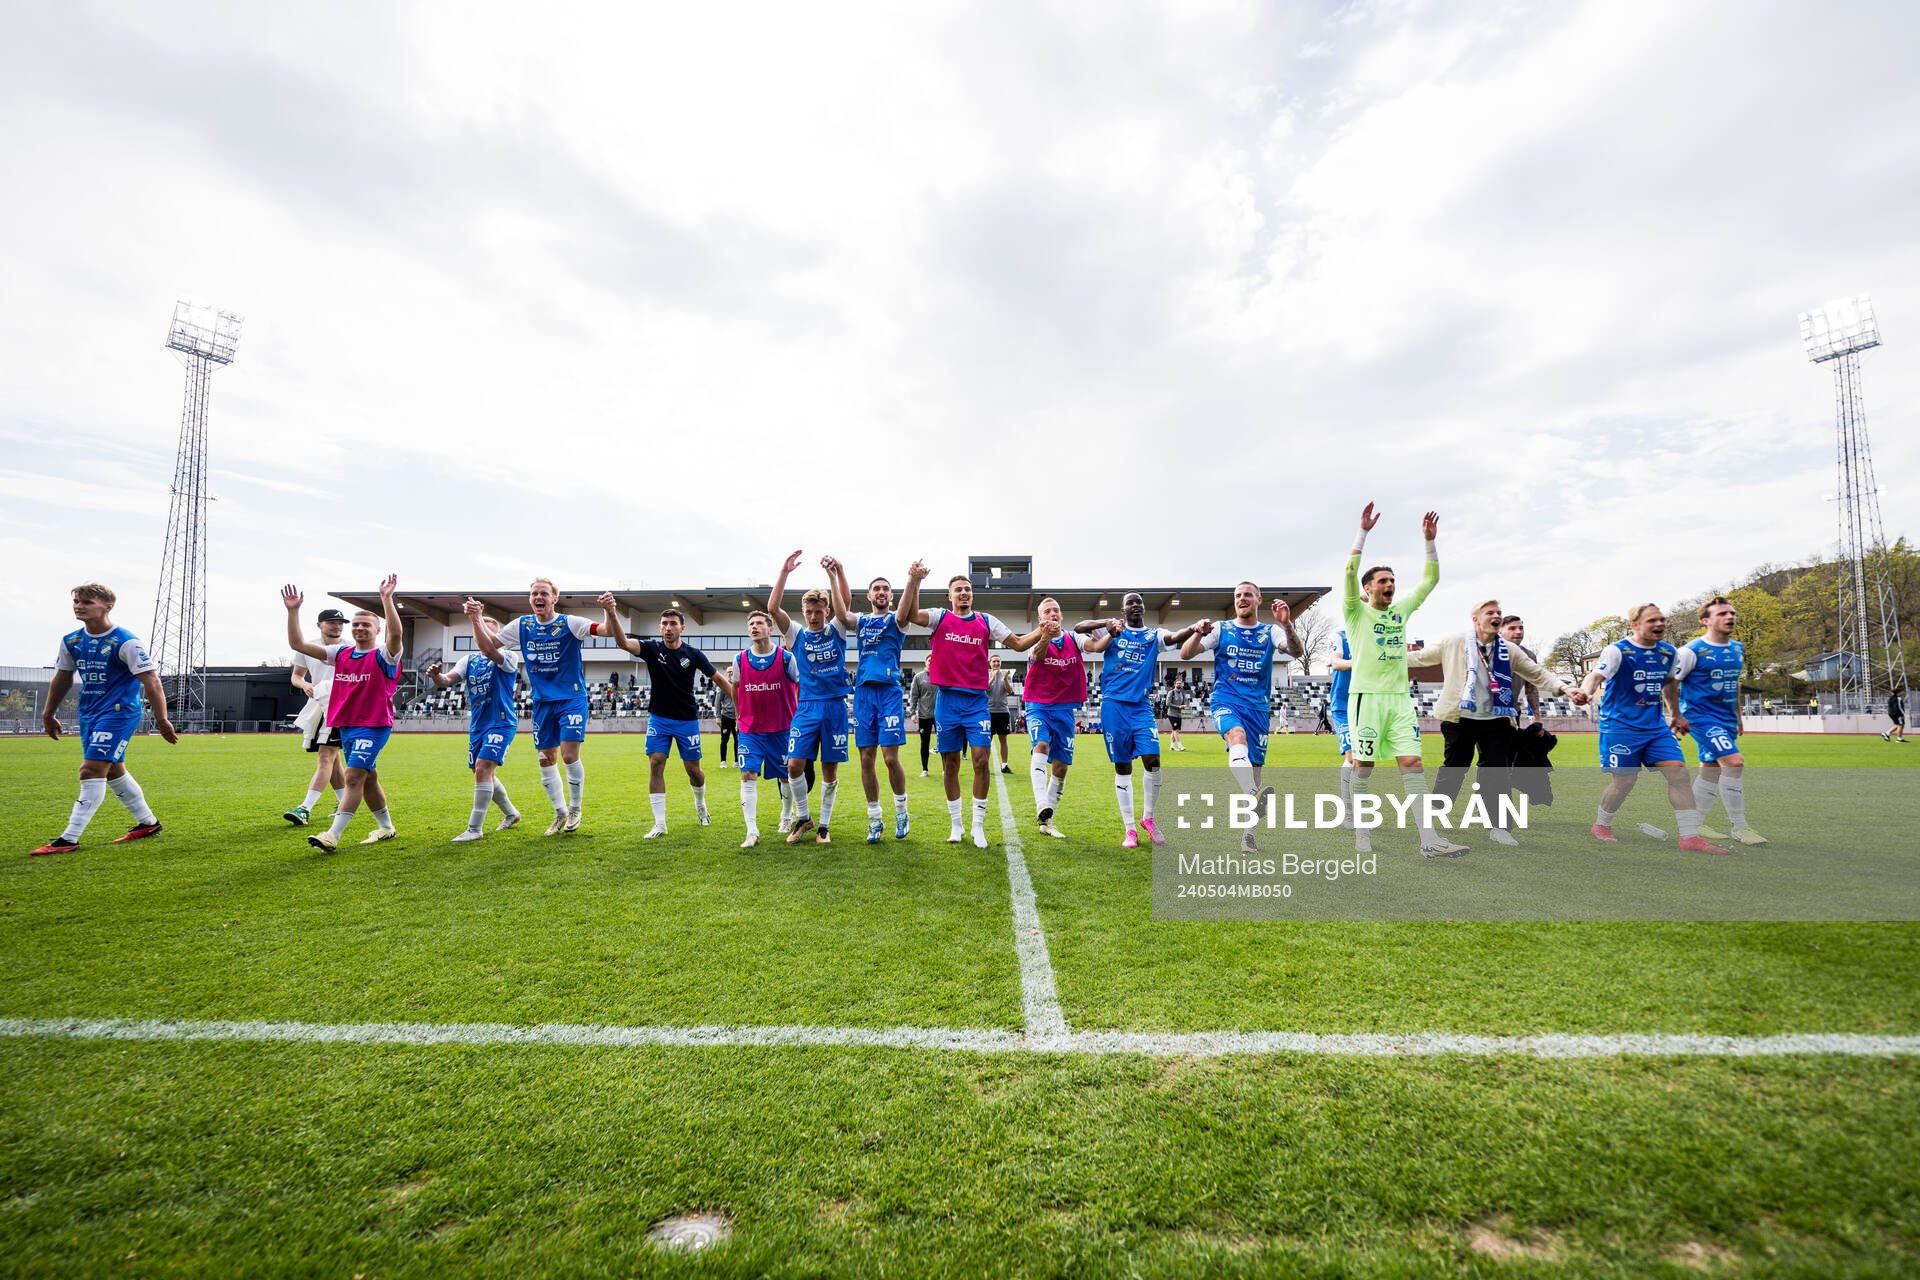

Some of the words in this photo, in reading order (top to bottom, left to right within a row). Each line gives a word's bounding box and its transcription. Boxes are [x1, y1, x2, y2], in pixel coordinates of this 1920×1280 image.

[944, 632, 983, 646] stadium
[537, 651, 561, 661] EBC
[816, 648, 838, 660] EBC
[1124, 650, 1146, 662] EBC
[1237, 659, 1262, 670] EBC
[335, 672, 371, 683] stadium
[744, 682, 781, 692] stadium
[567, 714, 584, 726] YP
[885, 715, 900, 728] YP
[92, 731, 113, 743] YP
[488, 733, 504, 744] YP
[833, 734, 847, 746] YP
[354, 738, 374, 750] YP
[788, 737, 796, 753] 8
[1358, 739, 1374, 756] 33
[1710, 735, 1733, 752] 16
[1609, 754, 1619, 768] 9
